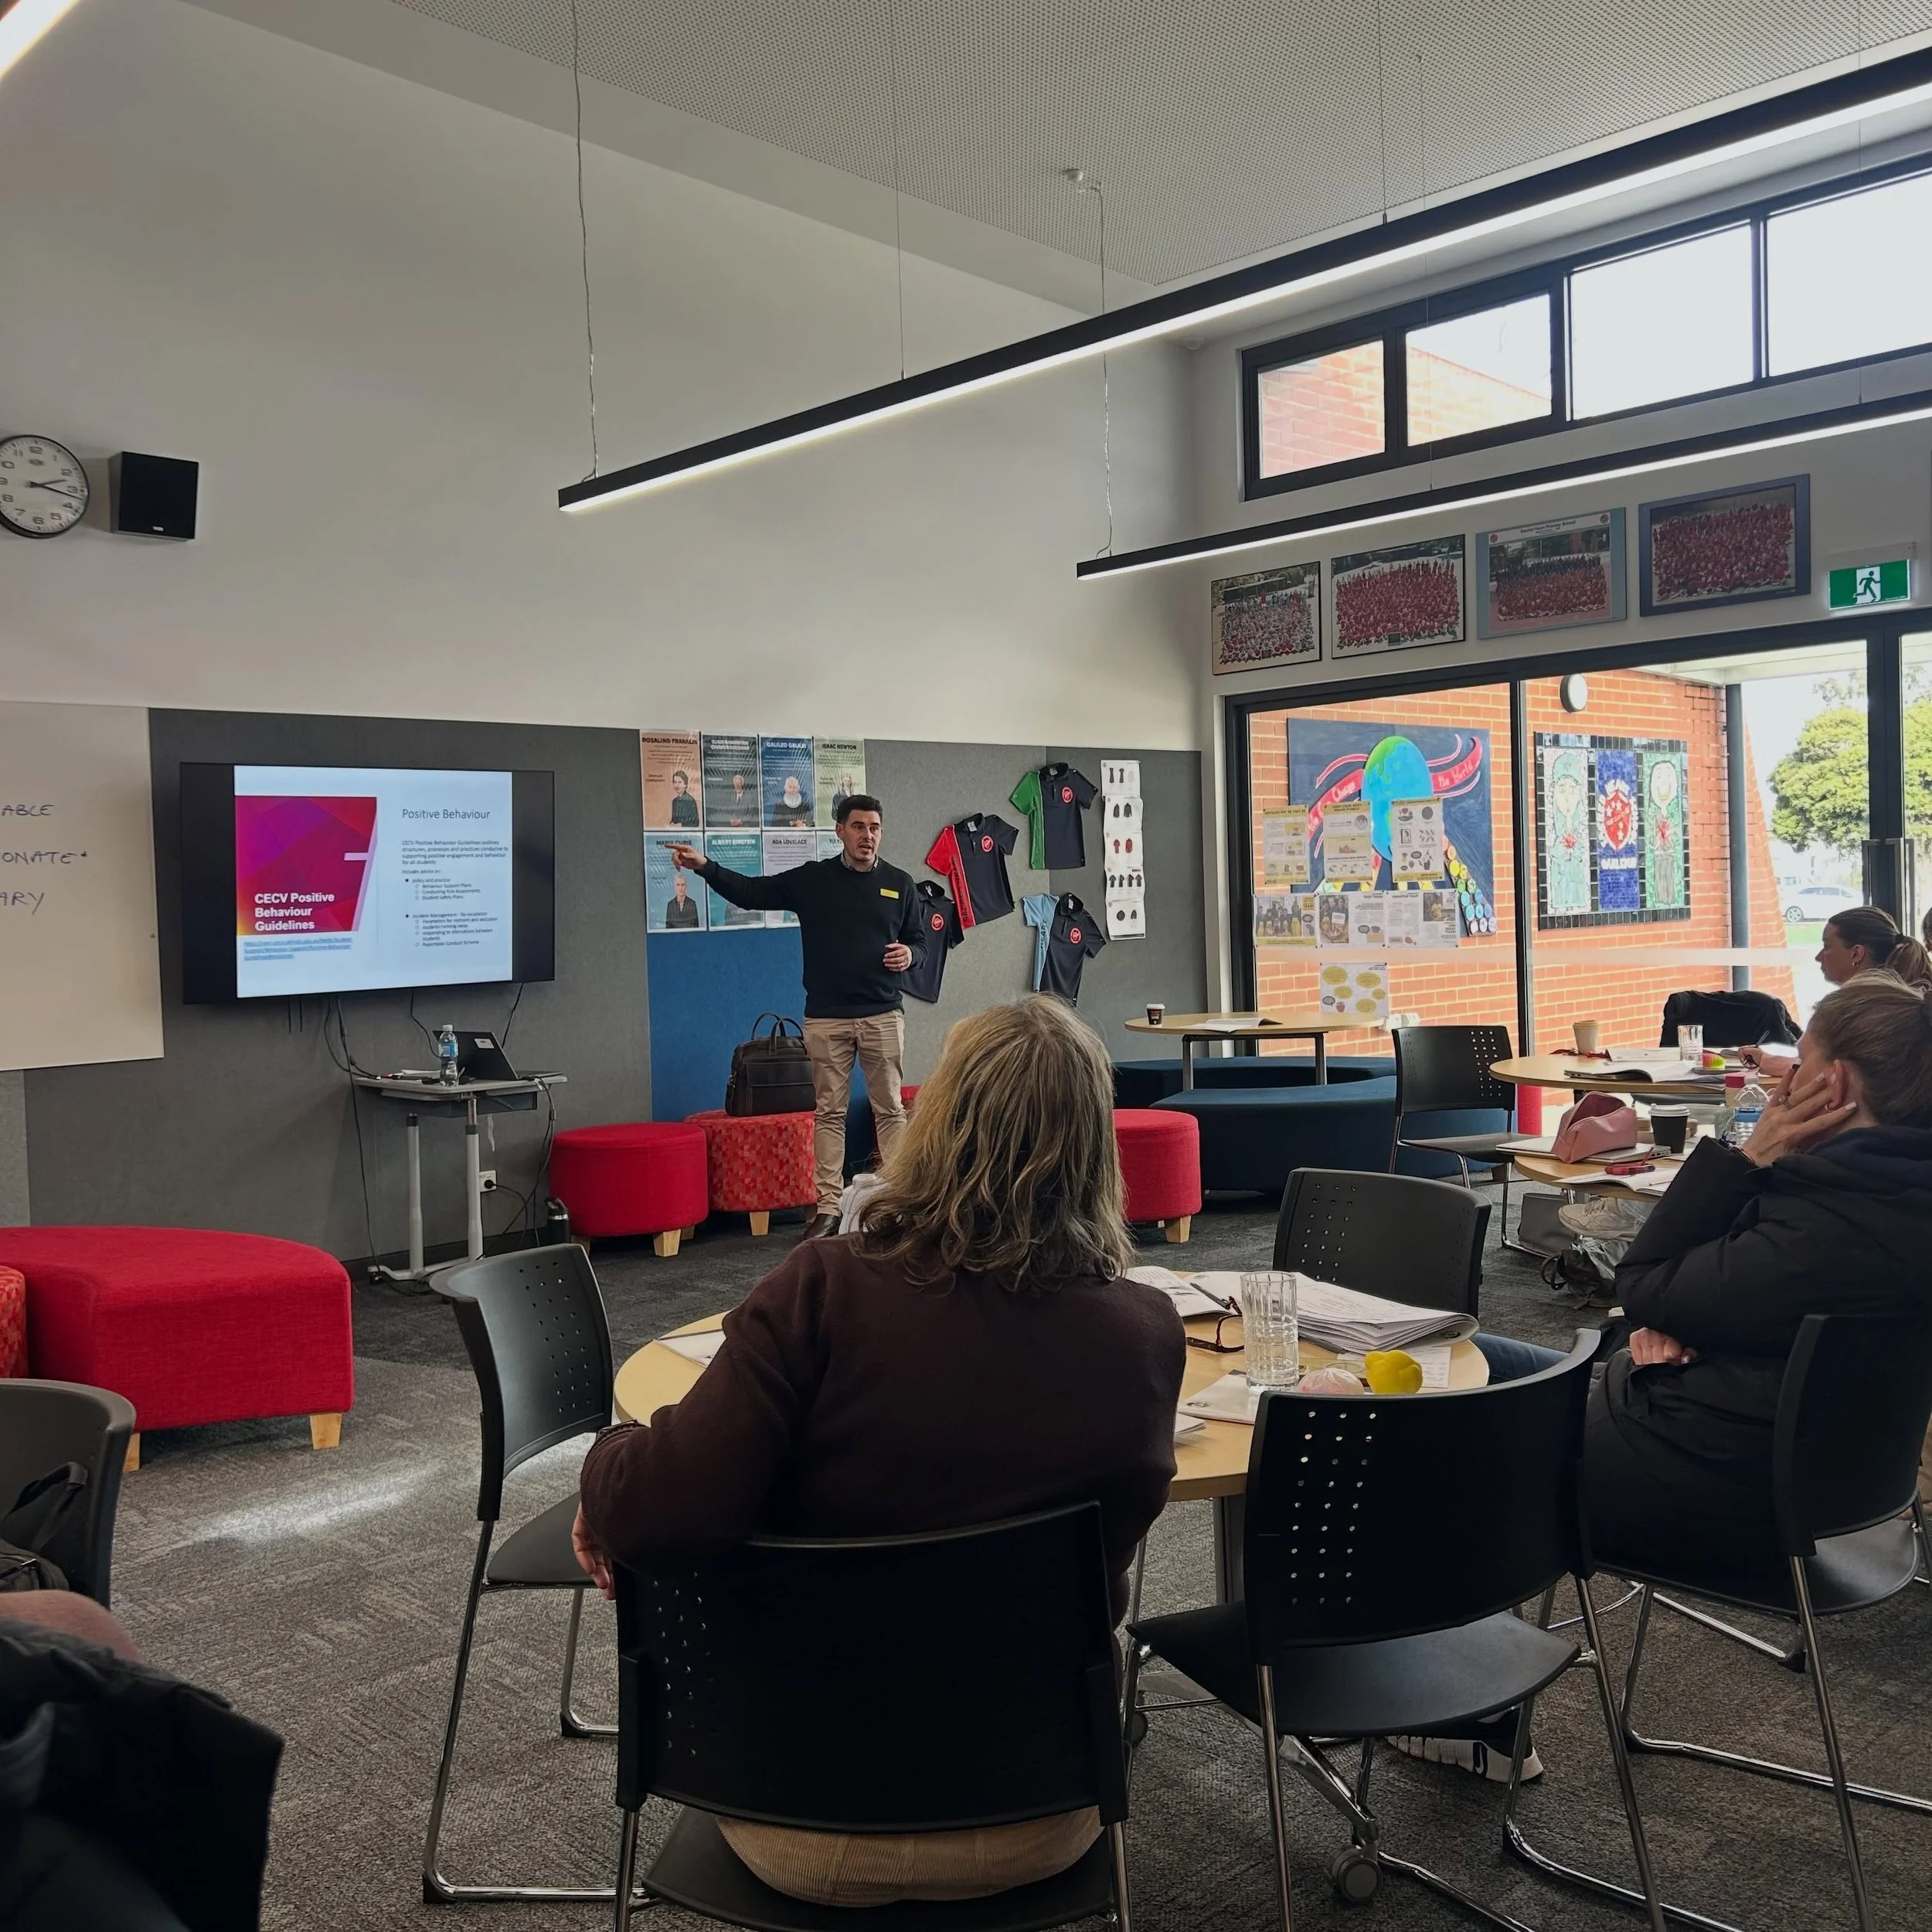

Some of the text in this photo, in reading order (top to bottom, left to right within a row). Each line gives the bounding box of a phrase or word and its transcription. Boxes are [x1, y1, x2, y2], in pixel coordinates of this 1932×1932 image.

[2, 494, 14, 502] 8
[32, 516, 44, 525] 6
[403, 809, 491, 818] Positive Behaviour
[254, 892, 335, 904] CECV Positive
[254, 906, 312, 918] Behaviour
[254, 920, 315, 931] Guidelines
